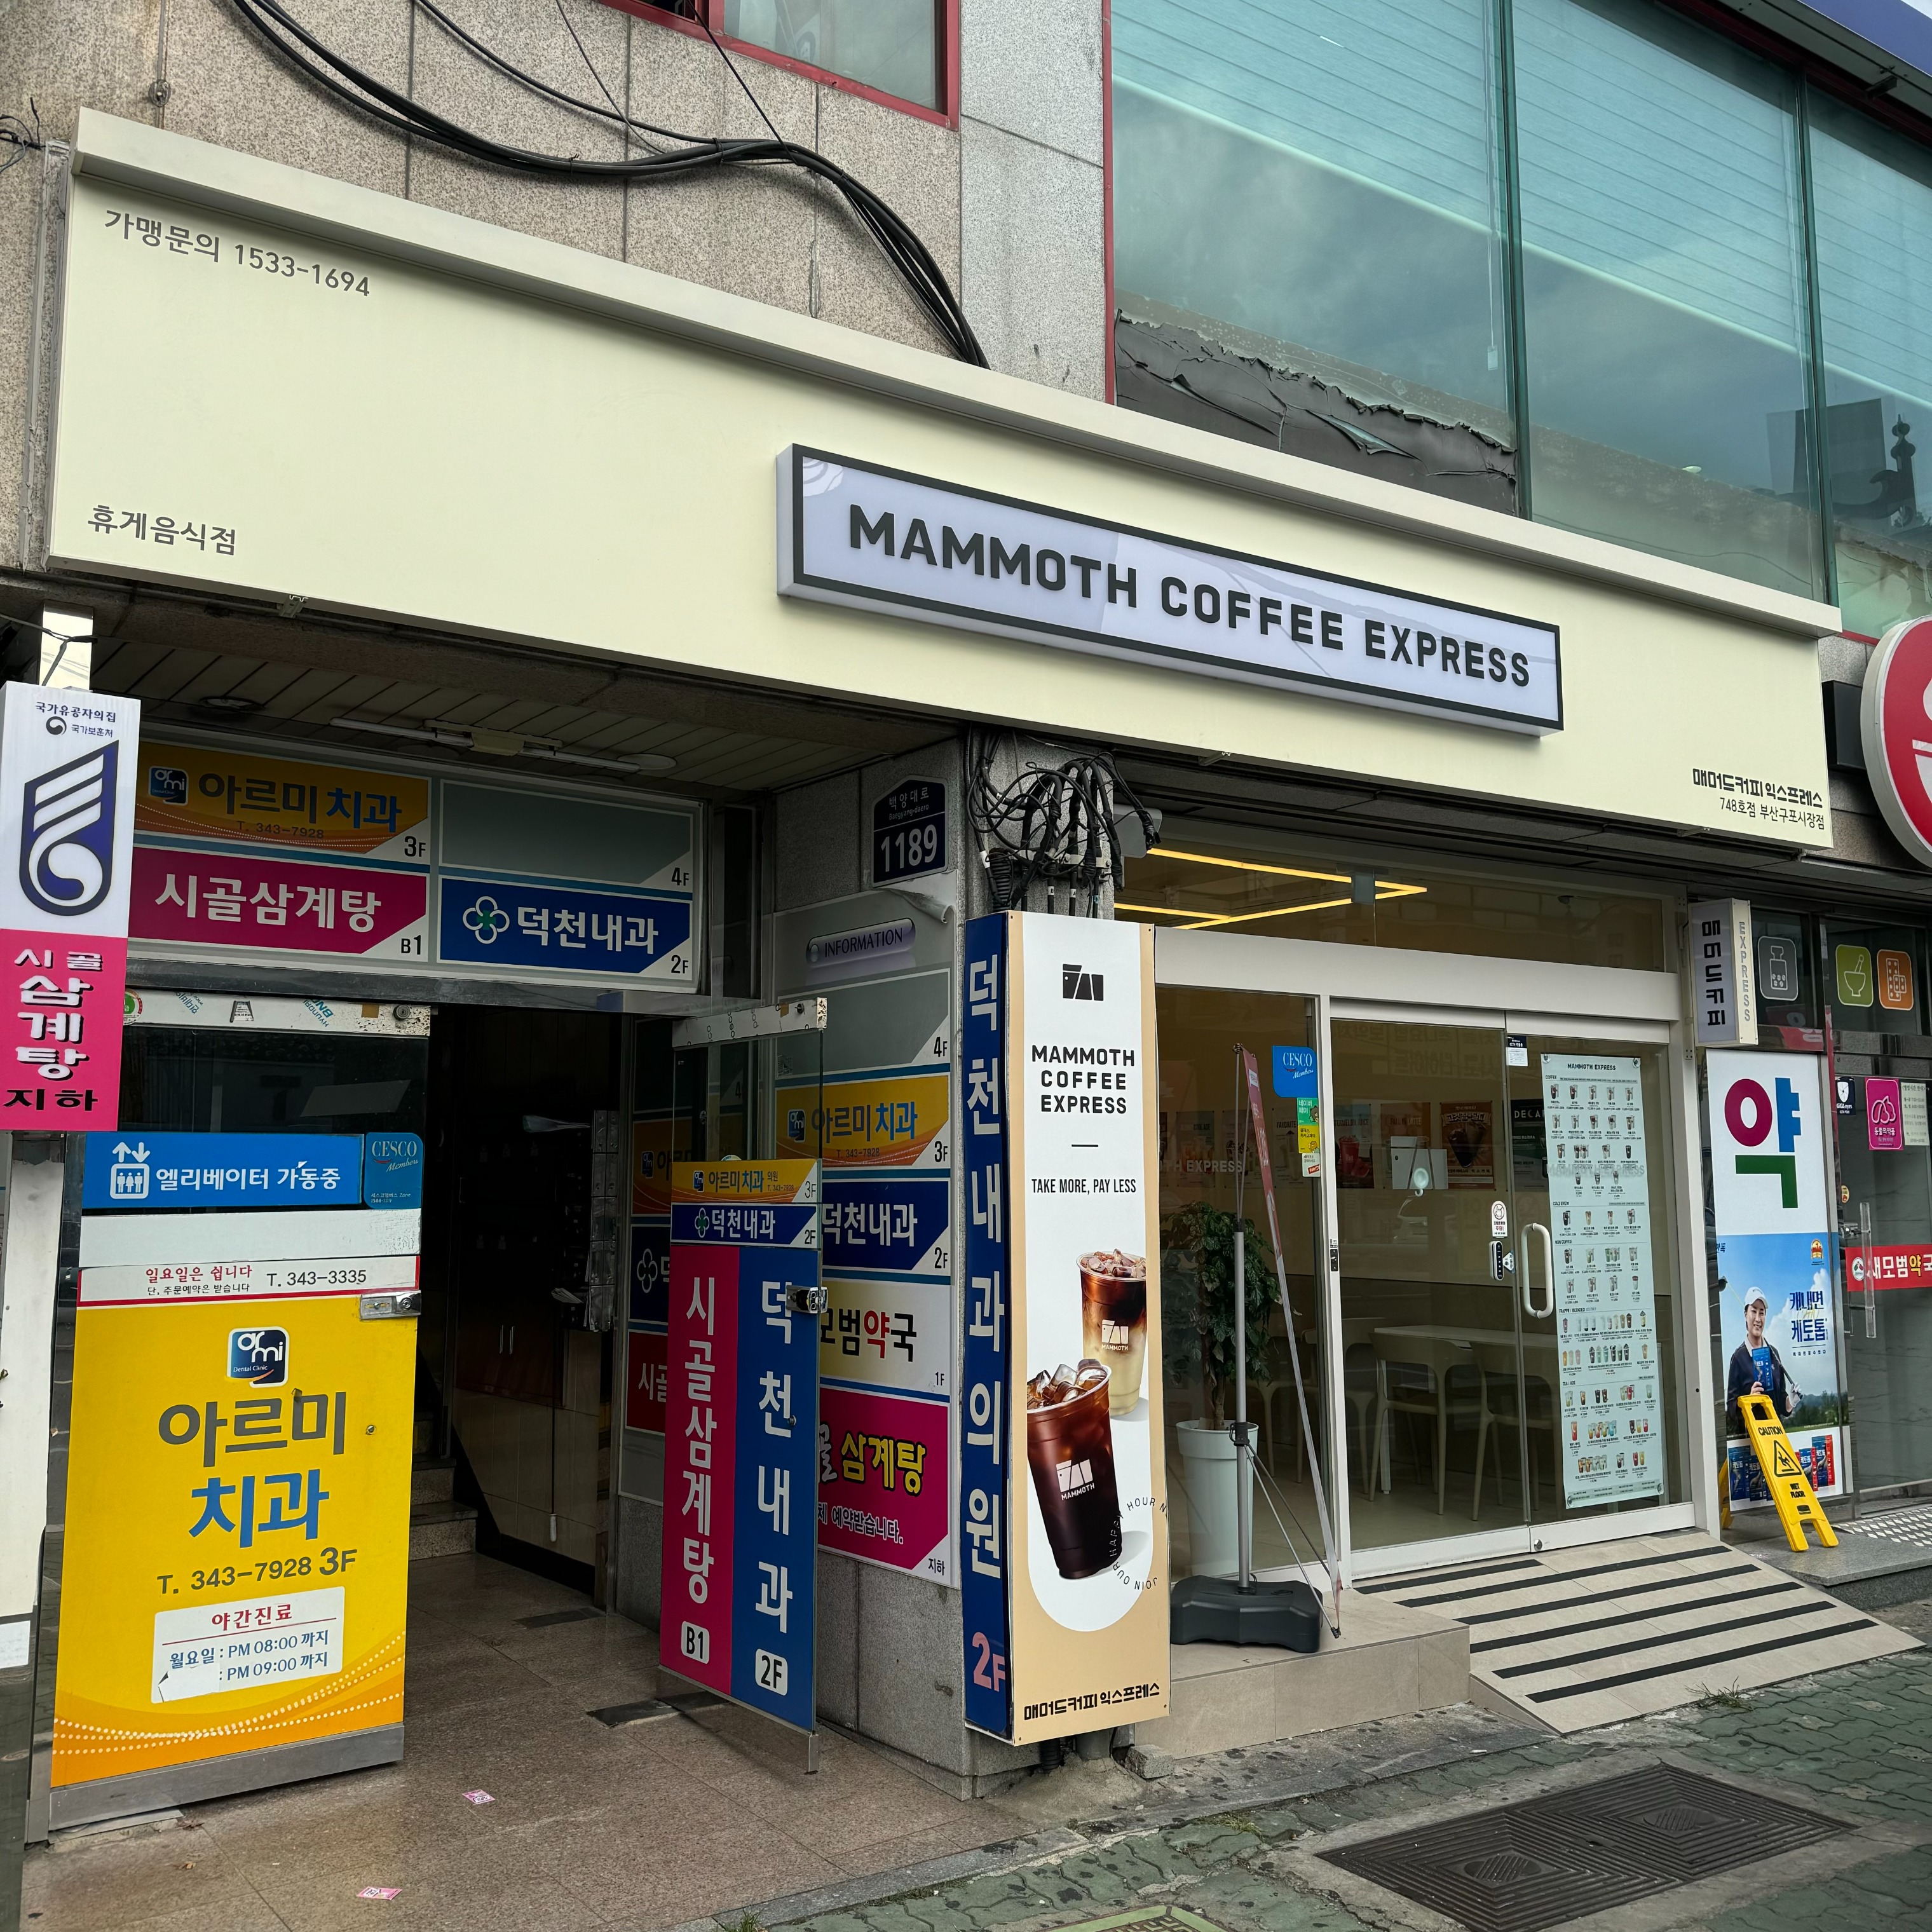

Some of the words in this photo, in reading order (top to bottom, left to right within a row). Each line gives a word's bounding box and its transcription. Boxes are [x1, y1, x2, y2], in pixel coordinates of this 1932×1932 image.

[104, 210, 220, 263] 가맹문의
[235, 244, 371, 297] 1533-1694
[87, 505, 236, 556] 휴게음식점
[850, 504, 1138, 608] MAMMOTH
[1161, 576, 1344, 651] COFFEE
[1365, 619, 1530, 687] EXPRESS
[71, 724, 113, 738] 국가보훈처
[889, 787, 929, 810] 백양대로
[888, 803, 929, 820] Baegyang-daero
[1720, 797, 1756, 819] 748호점
[1760, 804, 1825, 831] 부산구포시장점
[255, 822, 324, 840] 343-7928
[404, 836, 426, 857] 3F
[880, 824, 937, 873] 1189
[670, 867, 690, 887] 4F
[154, 873, 381, 933] 시골삼계탕
[517, 906, 659, 955] 덕천내과
[400, 934, 421, 955] B1
[824, 927, 903, 958] INFORMATION
[670, 954, 689, 974] 2F
[1738, 922, 1751, 1022] EXPRESS
[933, 1037, 948, 1058] 4F
[1031, 1045, 1134, 1066] MAMMOTH
[1282, 1052, 1312, 1067] CESCO
[1041, 1070, 1126, 1091] COFFEE
[3, 1088, 99, 1112] 지하
[1041, 1094, 1127, 1114] EXPRESS
[372, 1140, 418, 1157] CESCO
[845, 1147, 880, 1158] 343-7928
[934, 1140, 948, 1162] 3F
[1724, 1076, 1802, 1209] 약
[156, 1168, 269, 1191] 엘리베이터
[276, 1167, 341, 1190] 가동중
[767, 1171, 779, 1182] 의원
[773, 1183, 794, 1192] 343-7928
[1031, 1178, 1056, 1193] TAKE
[1059, 1179, 1090, 1195] MORE,
[1093, 1179, 1111, 1193] PAY
[1113, 1179, 1136, 1193] LESS
[805, 1181, 817, 1199] 3F
[712, 1209, 776, 1240] 덕천내과
[822, 1202, 918, 1247] 덕천내과
[804, 1229, 816, 1245] 2F
[934, 1246, 948, 1269] 2F
[966, 953, 1005, 1580] 덕천내과의원
[146, 1267, 203, 1284] 일요일은
[210, 1265, 253, 1281] 쉽니다
[266, 1273, 282, 1287] T.
[287, 1270, 367, 1286] 343-3335
[147, 1287, 160, 1296] 단,
[163, 1284, 210, 1296] 주문예약은
[214, 1283, 250, 1294] 받습니다
[1791, 1318, 1826, 1342] 케토톱
[935, 1371, 945, 1386] 1F
[158, 1392, 346, 1468] 아르미
[681, 1277, 718, 1604] 시골삼계탕
[1758, 1425, 1784, 1436] CAUTION
[755, 1281, 793, 1634] 덕천내과
[841, 1432, 926, 1494] 삼계탕
[1061, 1483, 1095, 1501] MAMMOTH
[1790, 1490, 1806, 1499] FLOOR
[188, 1469, 330, 1548] 치과
[1109, 1510, 1124, 1557] HAPPY
[1126, 1497, 1156, 1511] HOUR
[157, 1574, 179, 1595] T.
[190, 1556, 311, 1590] 343-7928
[319, 1547, 358, 1575] 3F
[928, 1557, 945, 1576] 지하
[1112, 1561, 1130, 1585] OUR
[1134, 1577, 1158, 1590] JOIN
[212, 1603, 292, 1631] 야간진료
[170, 1647, 215, 1670] 월요일
[228, 1643, 250, 1658] PM
[254, 1636, 298, 1654] 08:00
[301, 1629, 329, 1648] 까지
[686, 1626, 704, 1659] B1
[227, 1665, 250, 1681] PM
[253, 1657, 297, 1676] 09:00
[300, 1651, 328, 1670] 까지
[761, 1654, 782, 1689] 2F
[971, 1631, 1005, 1693] 2F
